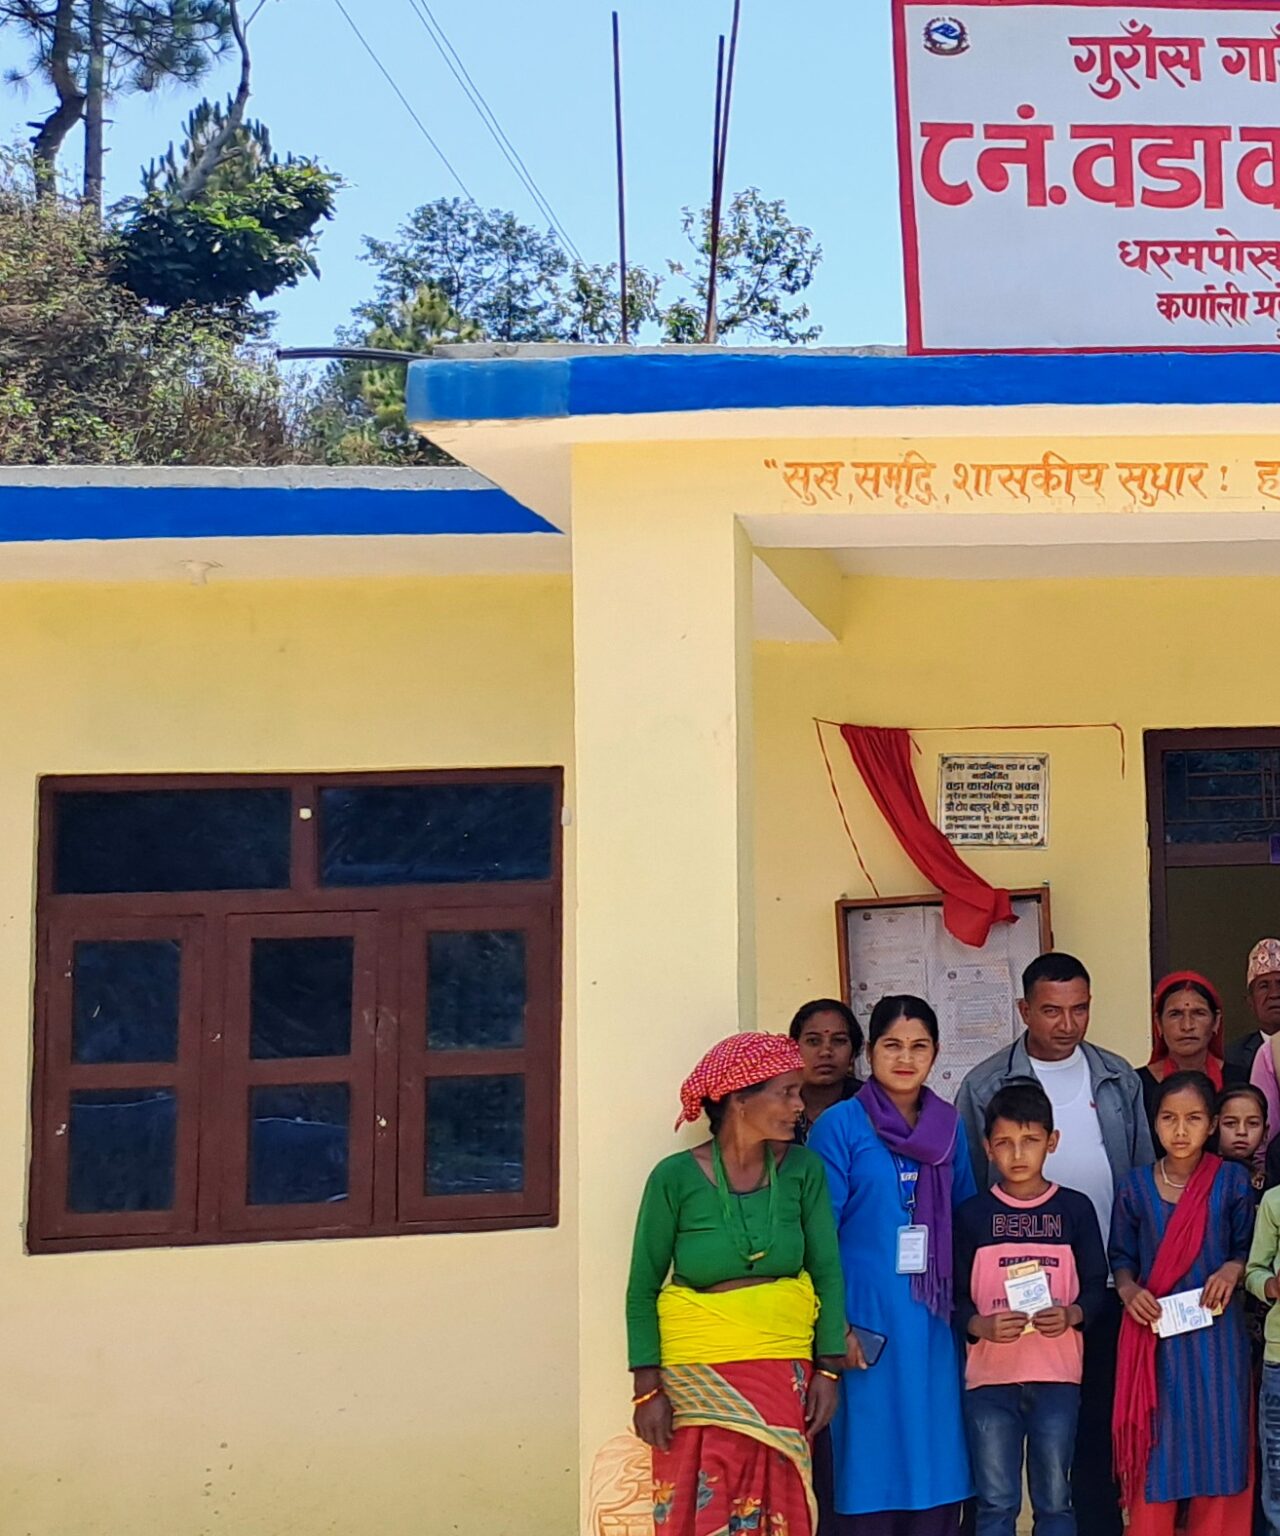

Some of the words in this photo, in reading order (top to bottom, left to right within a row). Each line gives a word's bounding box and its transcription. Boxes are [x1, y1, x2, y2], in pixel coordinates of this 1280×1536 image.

[1069, 20, 1206, 99] गुराँस
[952, 450, 1109, 506] शासकीय
[992, 1213, 1062, 1238] BERLIN
